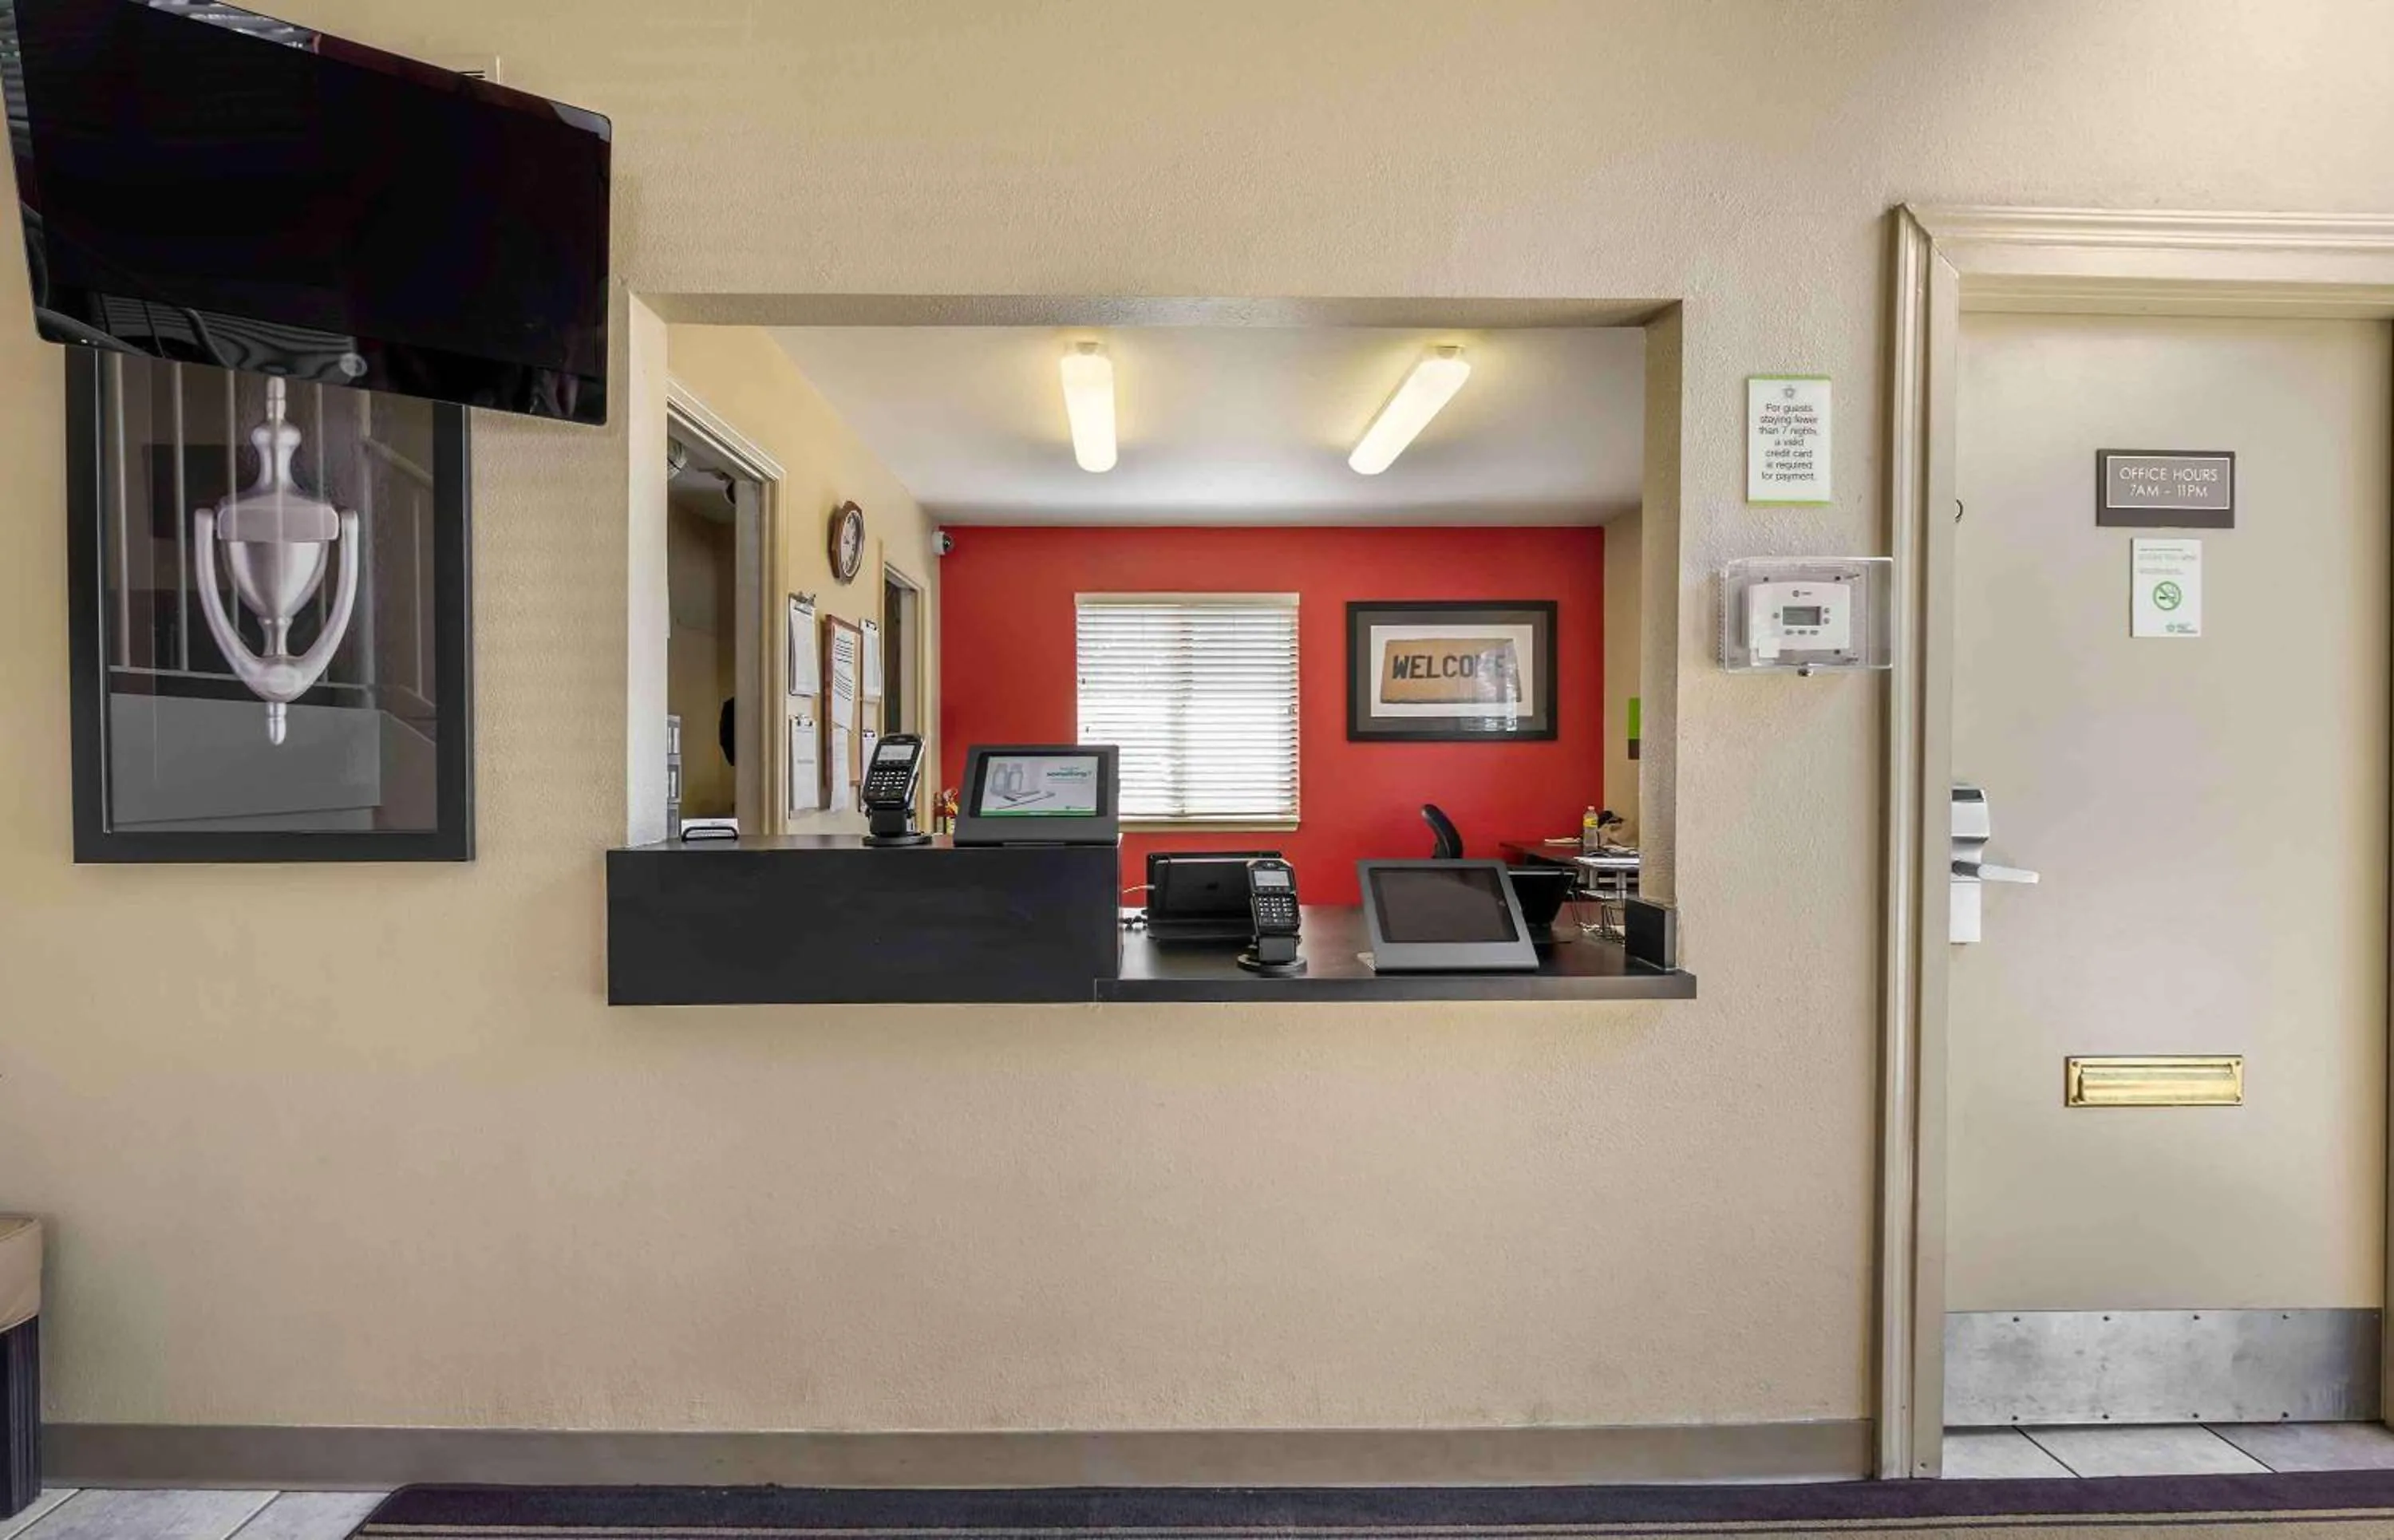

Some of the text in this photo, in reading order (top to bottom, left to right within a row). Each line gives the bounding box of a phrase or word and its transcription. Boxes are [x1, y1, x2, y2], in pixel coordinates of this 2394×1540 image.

[1766, 403, 1813, 415] For guests
[1760, 415, 1818, 426] staying fewer
[1759, 426, 1779, 435] than
[1784, 437, 1804, 446] valid
[1765, 448, 1812, 458] credit card
[1776, 460, 1812, 470] required
[1761, 472, 1773, 480] for
[2119, 467, 2218, 482] OFFICE HOURS
[2129, 484, 2159, 497] 7AM
[2177, 484, 2208, 498] 11PM
